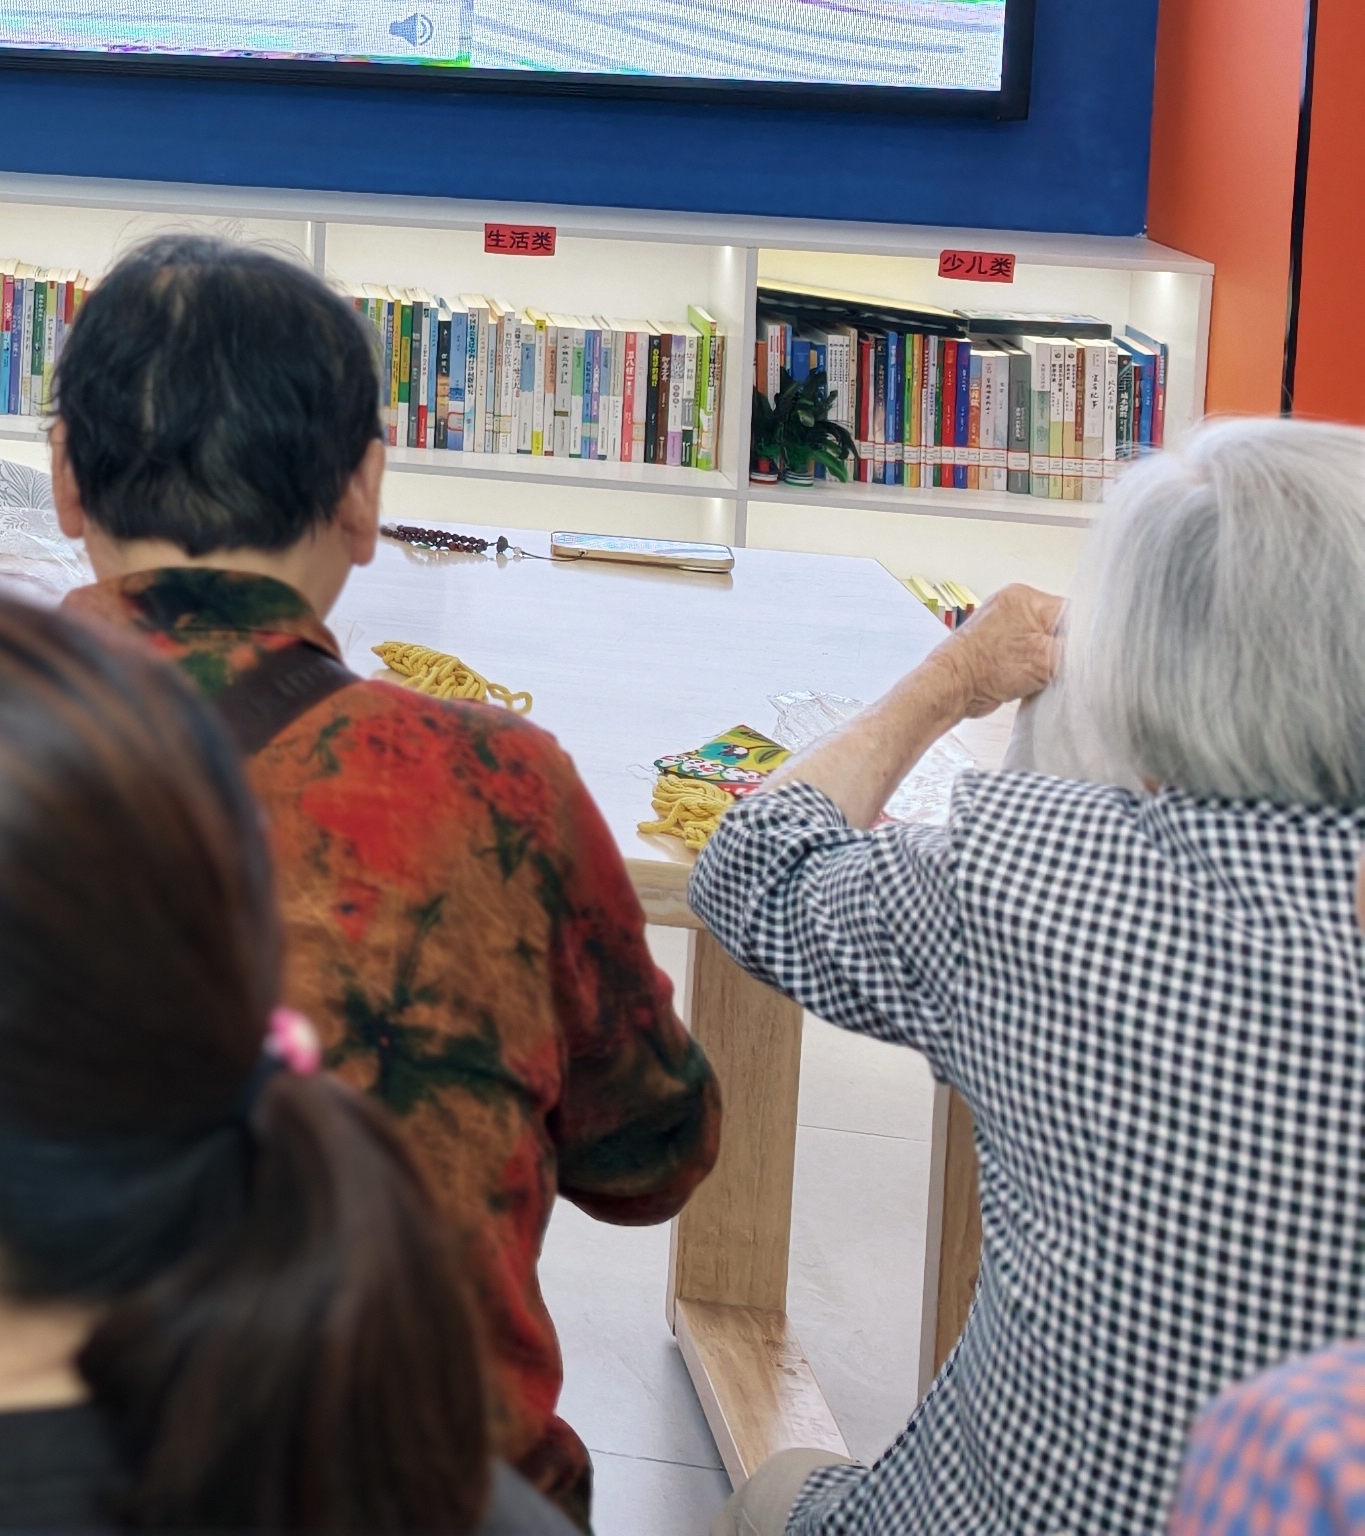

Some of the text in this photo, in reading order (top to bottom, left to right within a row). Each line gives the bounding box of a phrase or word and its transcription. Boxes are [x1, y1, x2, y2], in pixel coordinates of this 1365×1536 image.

[487, 229, 553, 251] 生活类
[942, 253, 1013, 278] 少儿类
